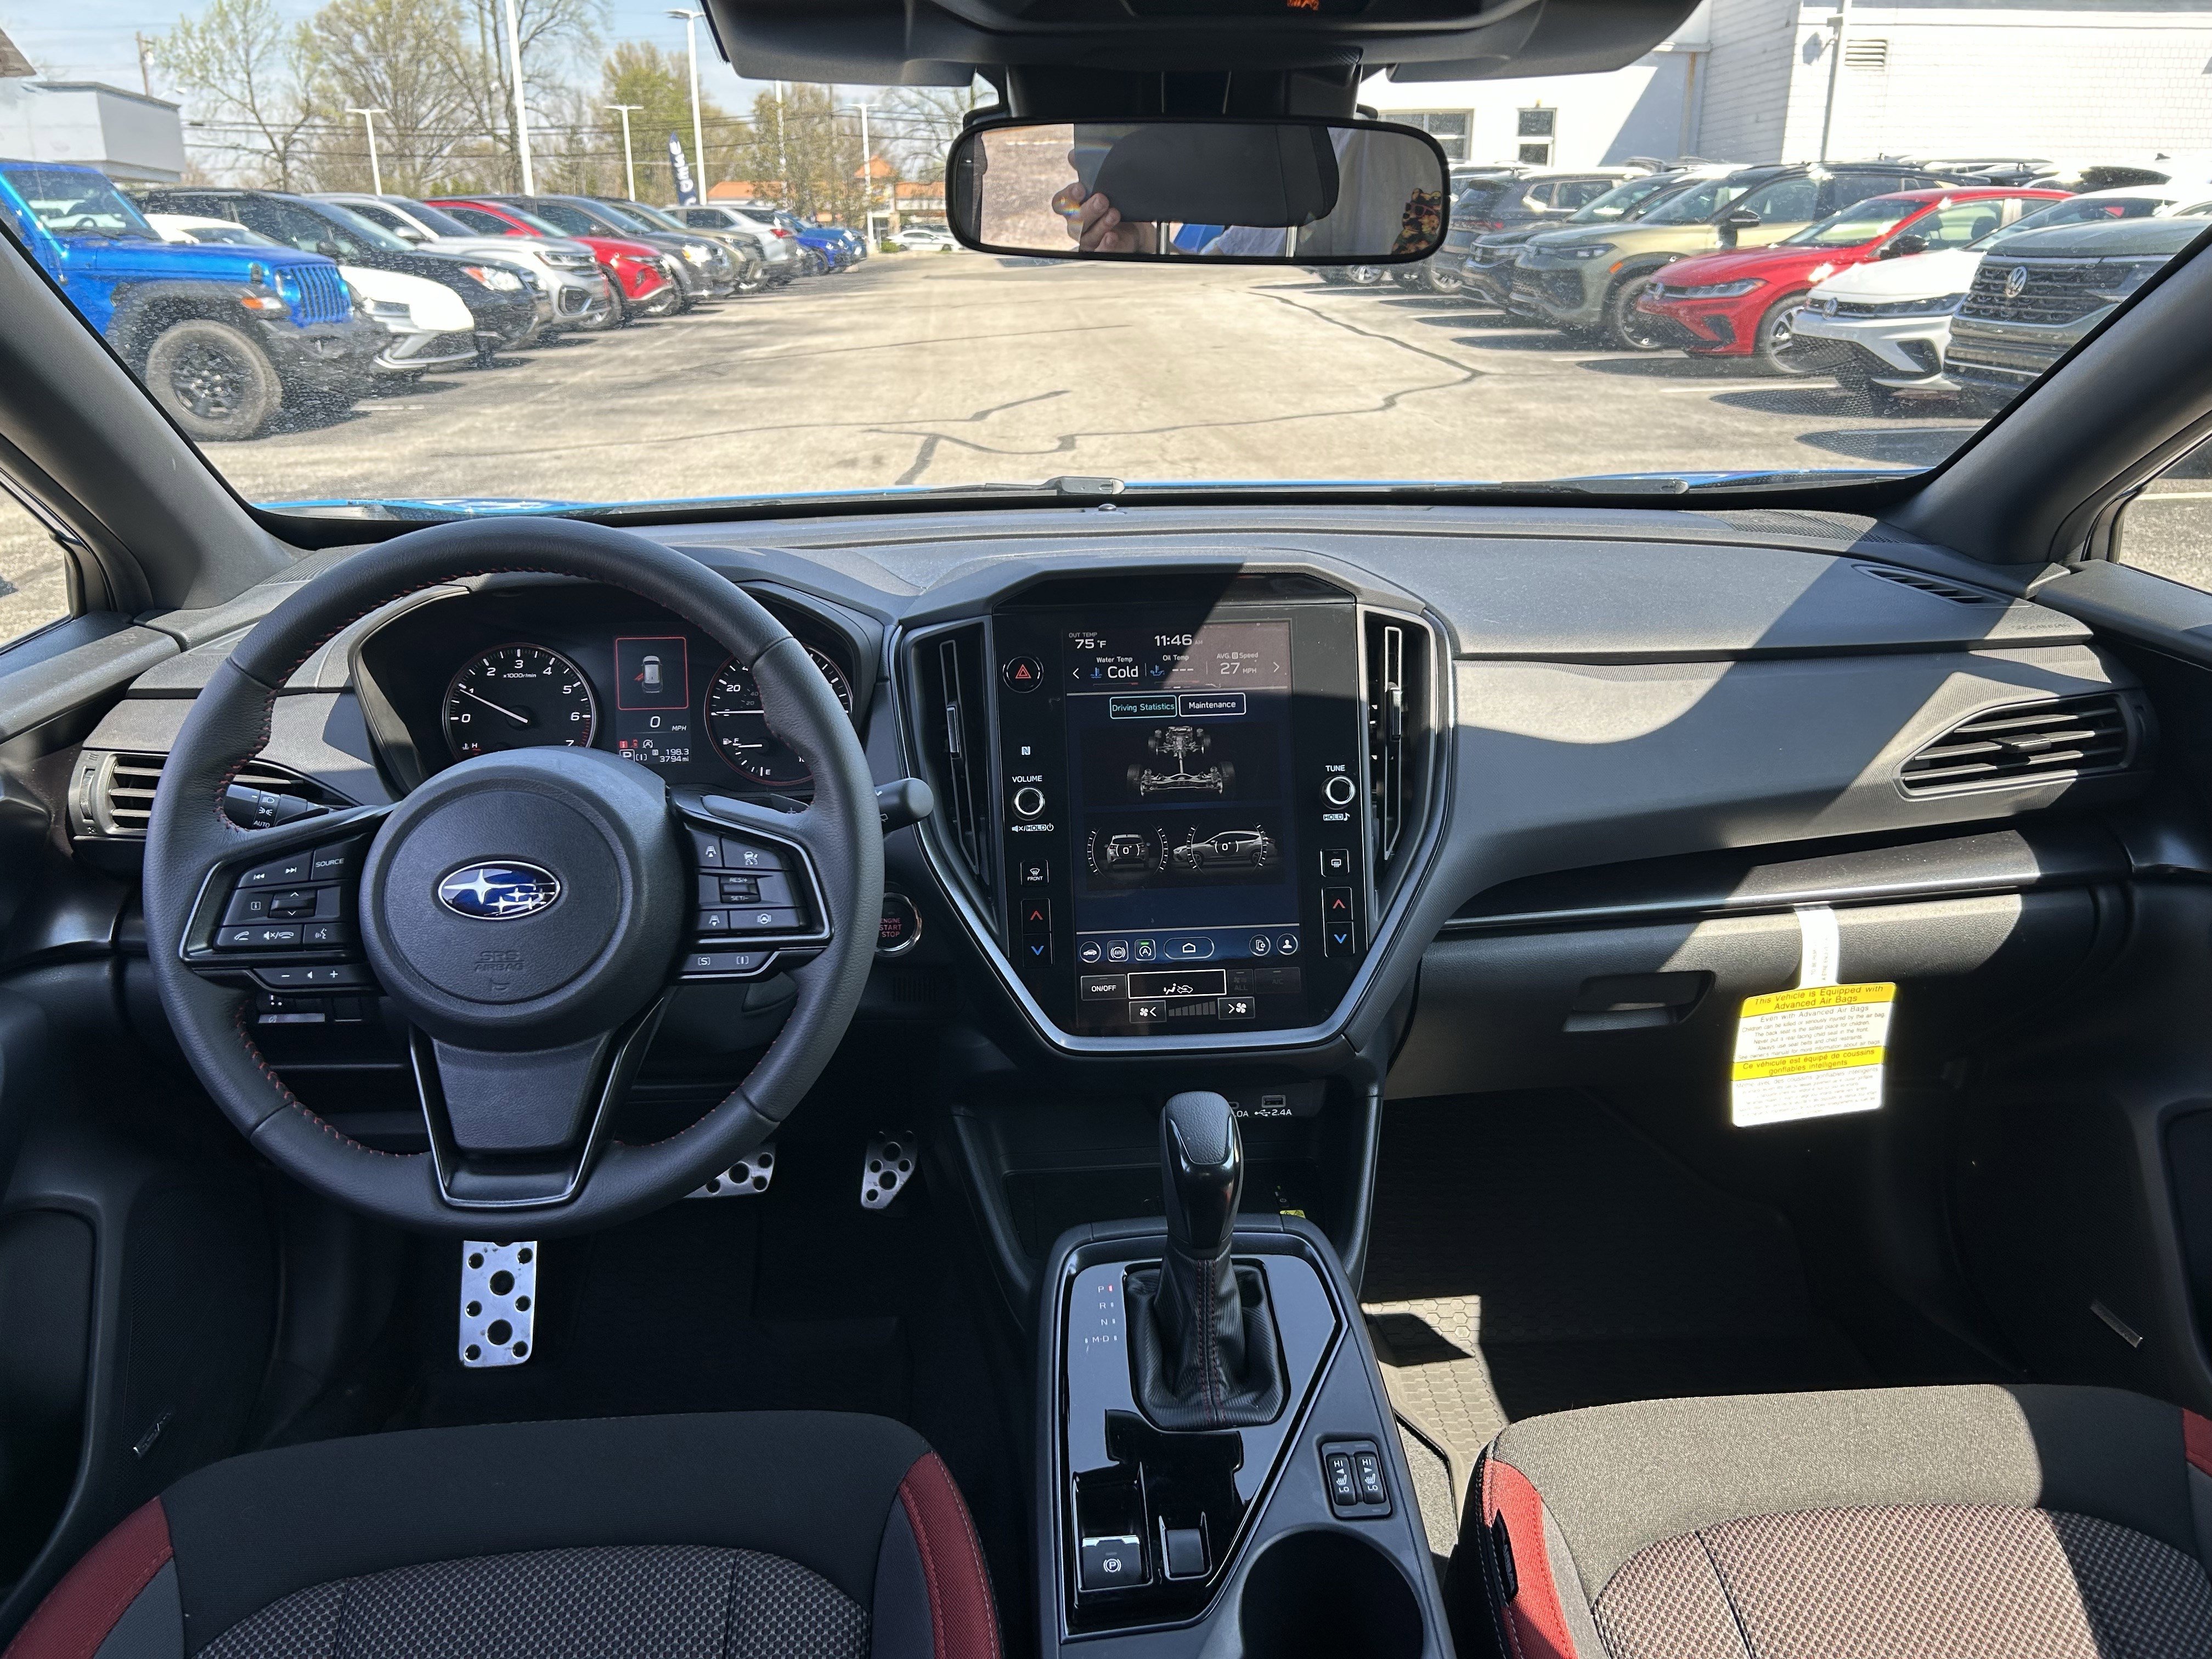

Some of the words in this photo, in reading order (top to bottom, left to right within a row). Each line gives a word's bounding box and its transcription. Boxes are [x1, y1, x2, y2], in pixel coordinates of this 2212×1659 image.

[1075, 639, 1094, 649] 75
[1154, 634, 1192, 646] 11:46
[515, 659, 523, 669] 3
[1220, 662, 1240, 674] 27
[487, 667, 496, 676] 2
[543, 667, 552, 675] 4
[1108, 665, 1139, 678] Cold
[562, 685, 572, 694] 5
[1139, 703, 1175, 711] Statistics
[1188, 701, 1236, 709] Maintenance
[461, 714, 471, 723] 0
[571, 712, 580, 721] 6
[650, 716, 661, 728] 0
[315, 858, 345, 867] SOURCE
[1775, 992, 1805, 1001] Vehicle
[1820, 986, 1861, 996] Equipped
[1774, 998, 1816, 1010] Advanced
[1836, 996, 1858, 1005] Bags
[1799, 1008, 1834, 1018] Advanced
[1757, 1059, 1786, 1068] véhicule
[1843, 1049, 1875, 1058] coussins
[1769, 1065, 1806, 1076] gonflables
[1809, 1059, 1848, 1070] intelligents
